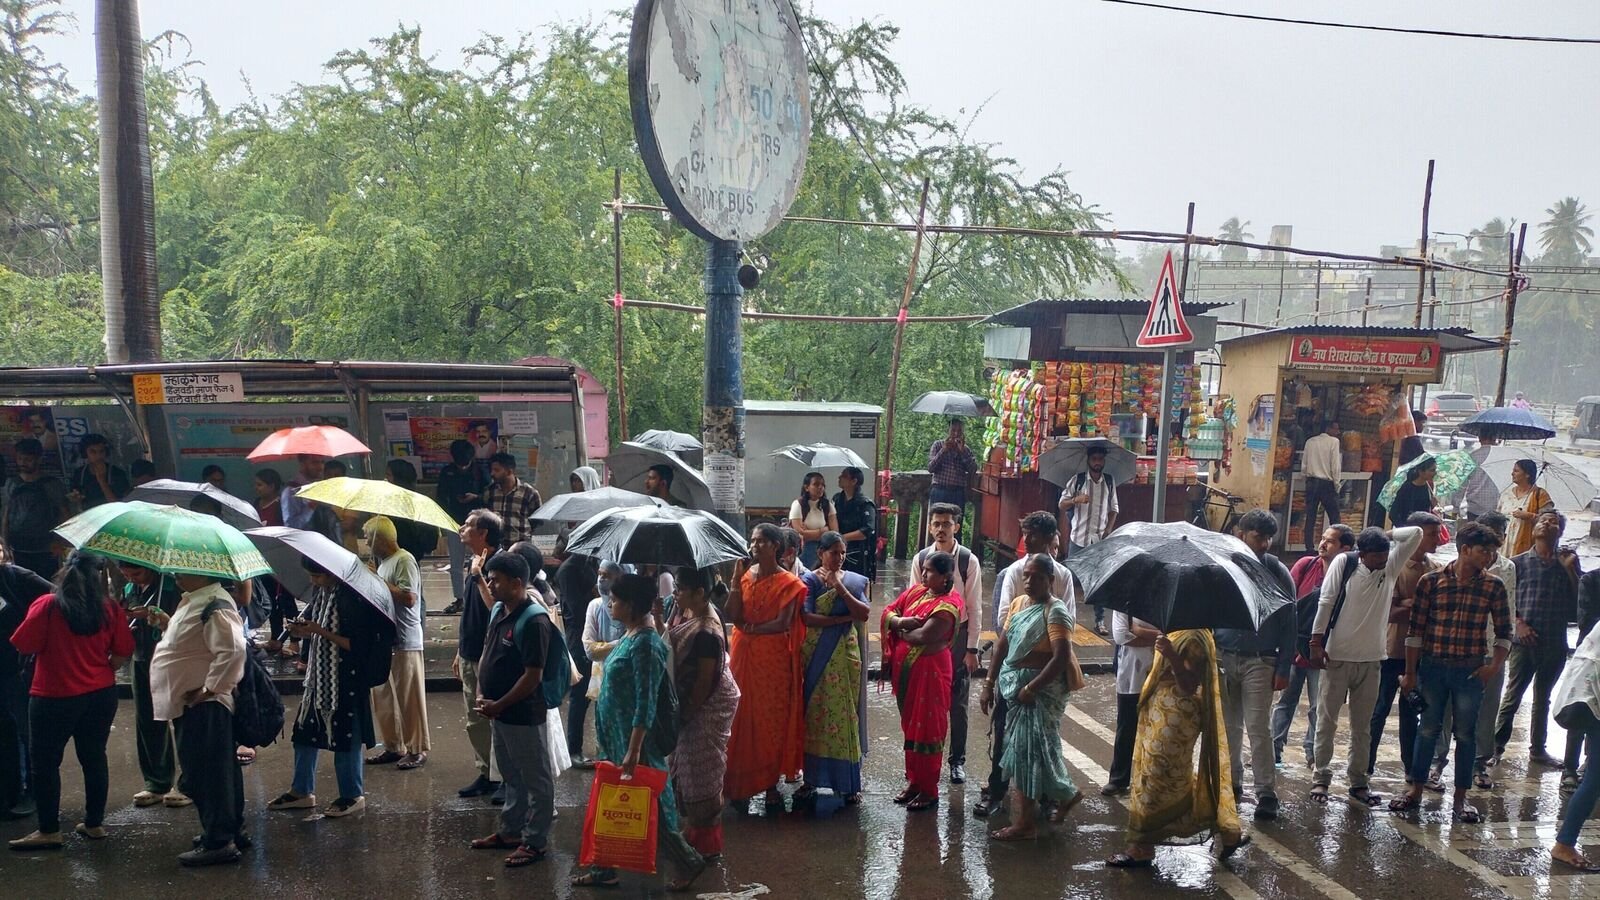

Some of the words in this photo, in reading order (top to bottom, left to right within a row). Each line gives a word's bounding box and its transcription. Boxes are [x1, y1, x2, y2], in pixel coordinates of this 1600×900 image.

[728, 191, 754, 215] BUS
[1312, 348, 1327, 361] जय
[1388, 352, 1417, 365] फरसाण
[230, 385, 234, 393] ३
